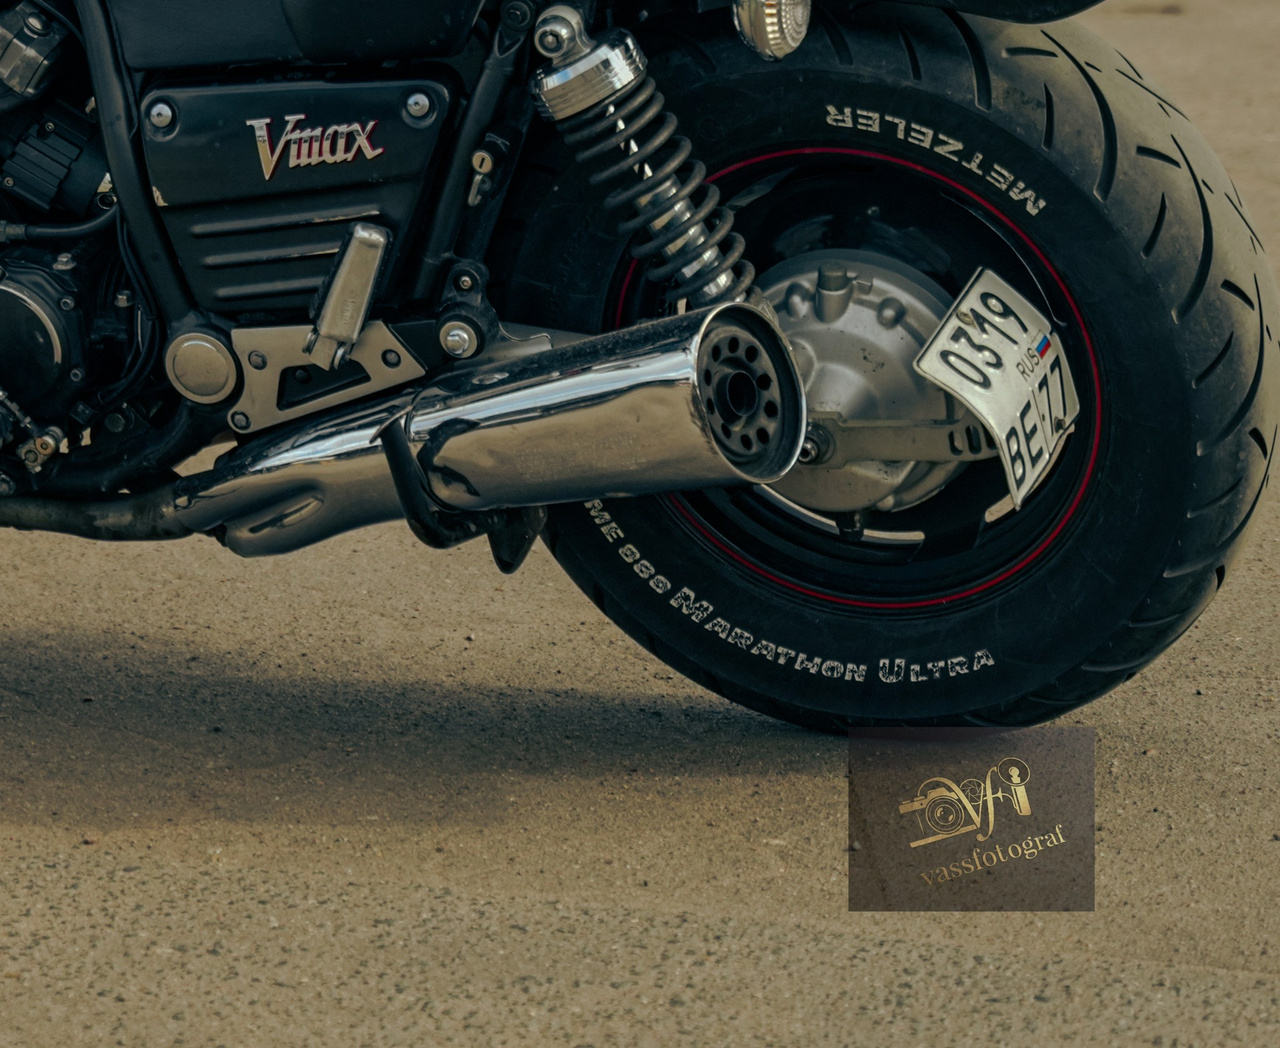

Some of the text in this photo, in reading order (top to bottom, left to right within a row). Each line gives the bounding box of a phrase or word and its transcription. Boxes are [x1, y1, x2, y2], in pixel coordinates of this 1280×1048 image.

[246, 113, 385, 181] Vmax
[825, 104, 1047, 217] METZELER
[939, 291, 1029, 390] 0319
[1016, 347, 1041, 382] RUS
[1038, 354, 1067, 437] 77
[670, 586, 868, 683] MARATHON
[878, 649, 995, 683] ULTRA
